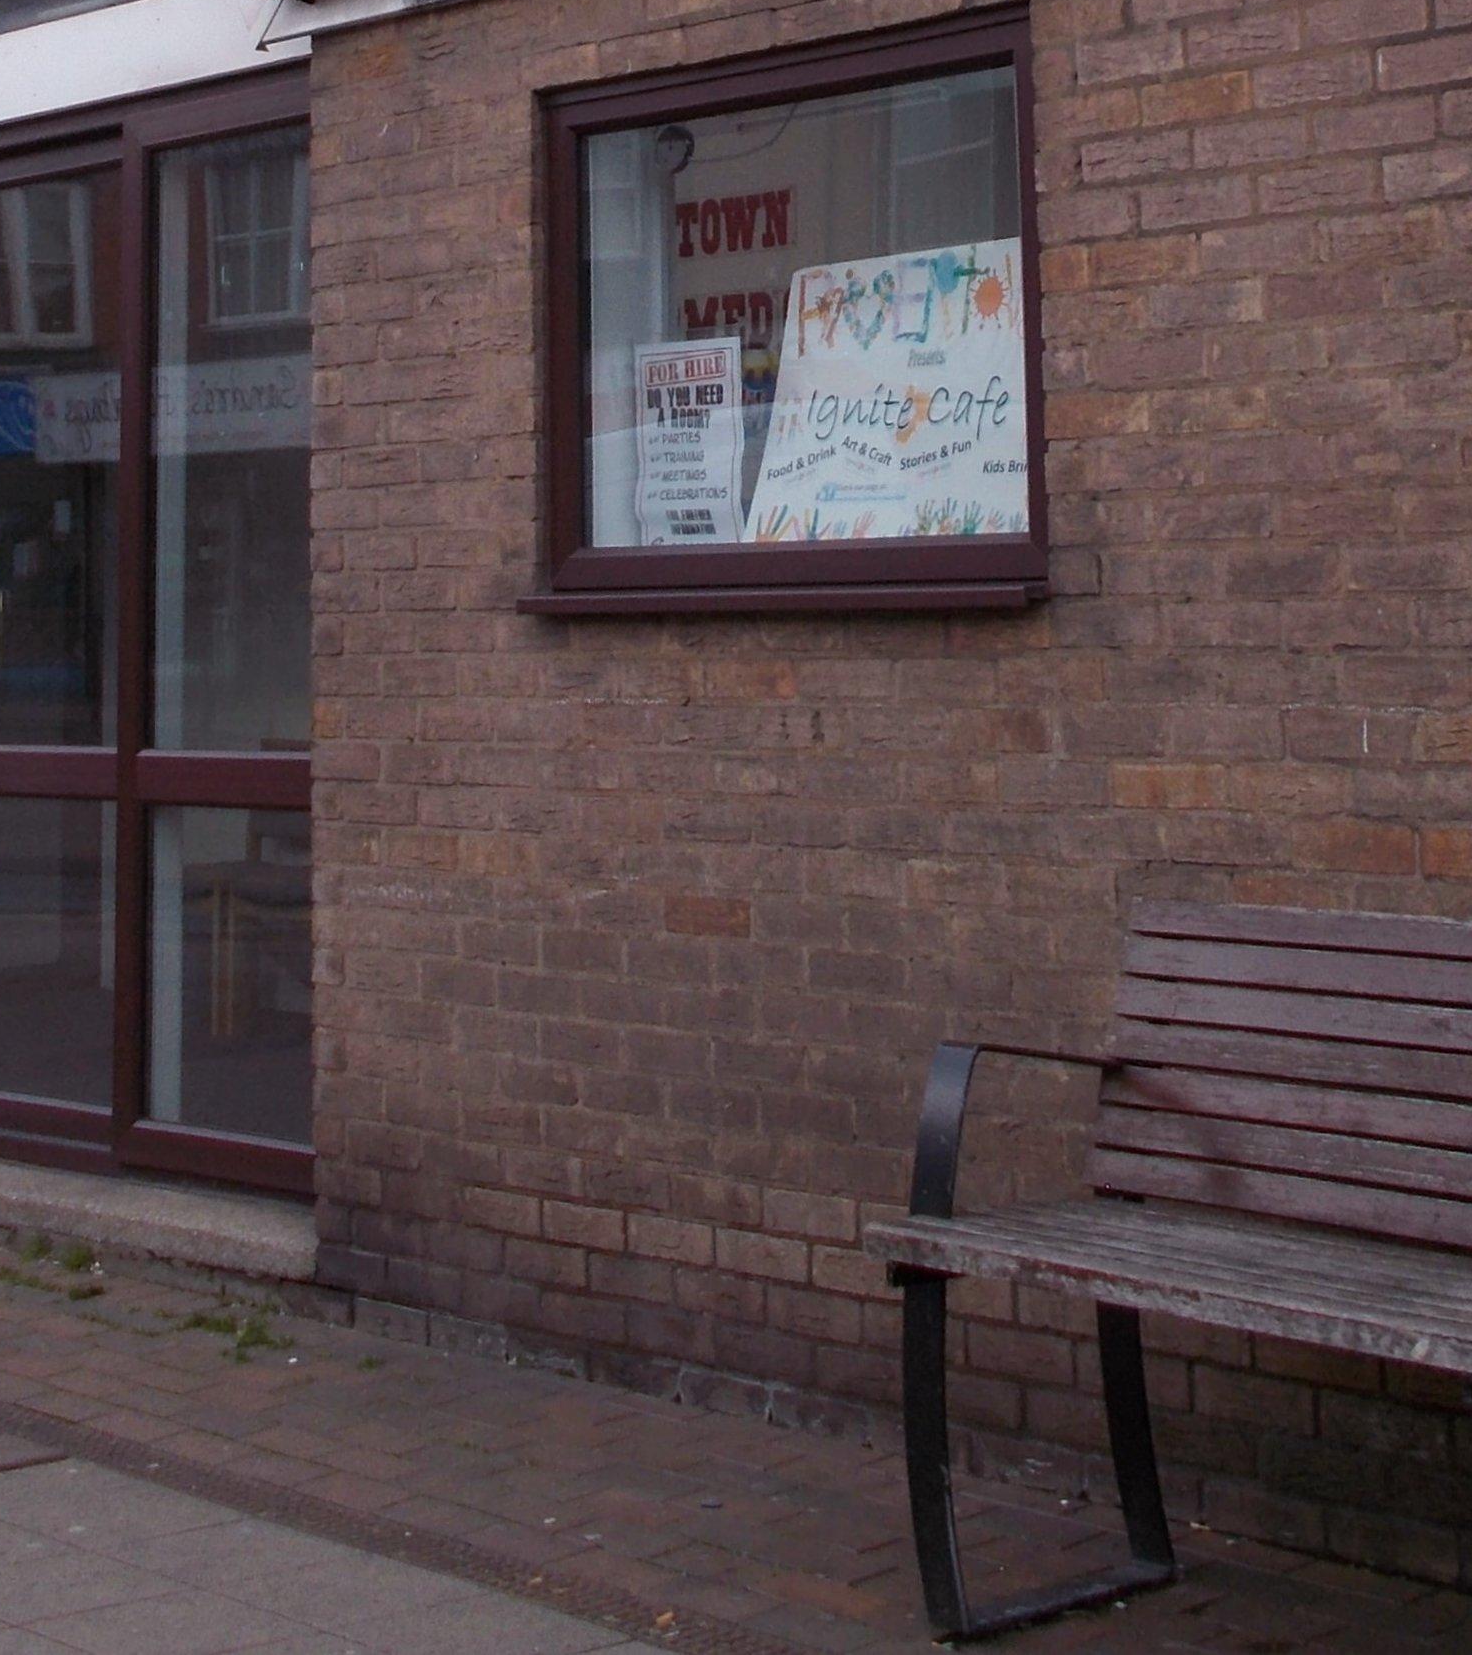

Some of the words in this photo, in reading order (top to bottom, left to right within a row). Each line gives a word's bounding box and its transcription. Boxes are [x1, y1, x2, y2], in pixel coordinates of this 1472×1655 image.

[676, 189, 791, 258] TOWN
[648, 362, 679, 384] FOR
[684, 354, 724, 379] HIRE
[646, 387, 662, 409] DO
[667, 385, 691, 407] YOU
[695, 383, 724, 405] NEED
[807, 383, 914, 441] Ignite
[928, 375, 1010, 441] Cafe
[657, 407, 665, 428] A
[671, 407, 711, 429] ROOM?
[662, 431, 701, 445] PARTIES
[842, 435, 859, 452] Art
[858, 443, 868, 456] &
[868, 447, 893, 467] Craft
[767, 460, 794, 481] Food
[795, 456, 805, 470] &
[807, 445, 837, 465] Drink
[899, 450, 938, 471] Stories
[939, 444, 949, 458] &
[952, 439, 973, 456] Fun
[982, 459, 1006, 474] Kids
[661, 468, 707, 482] MEETINGS
[659, 486, 729, 501] CELEBRATIONS
